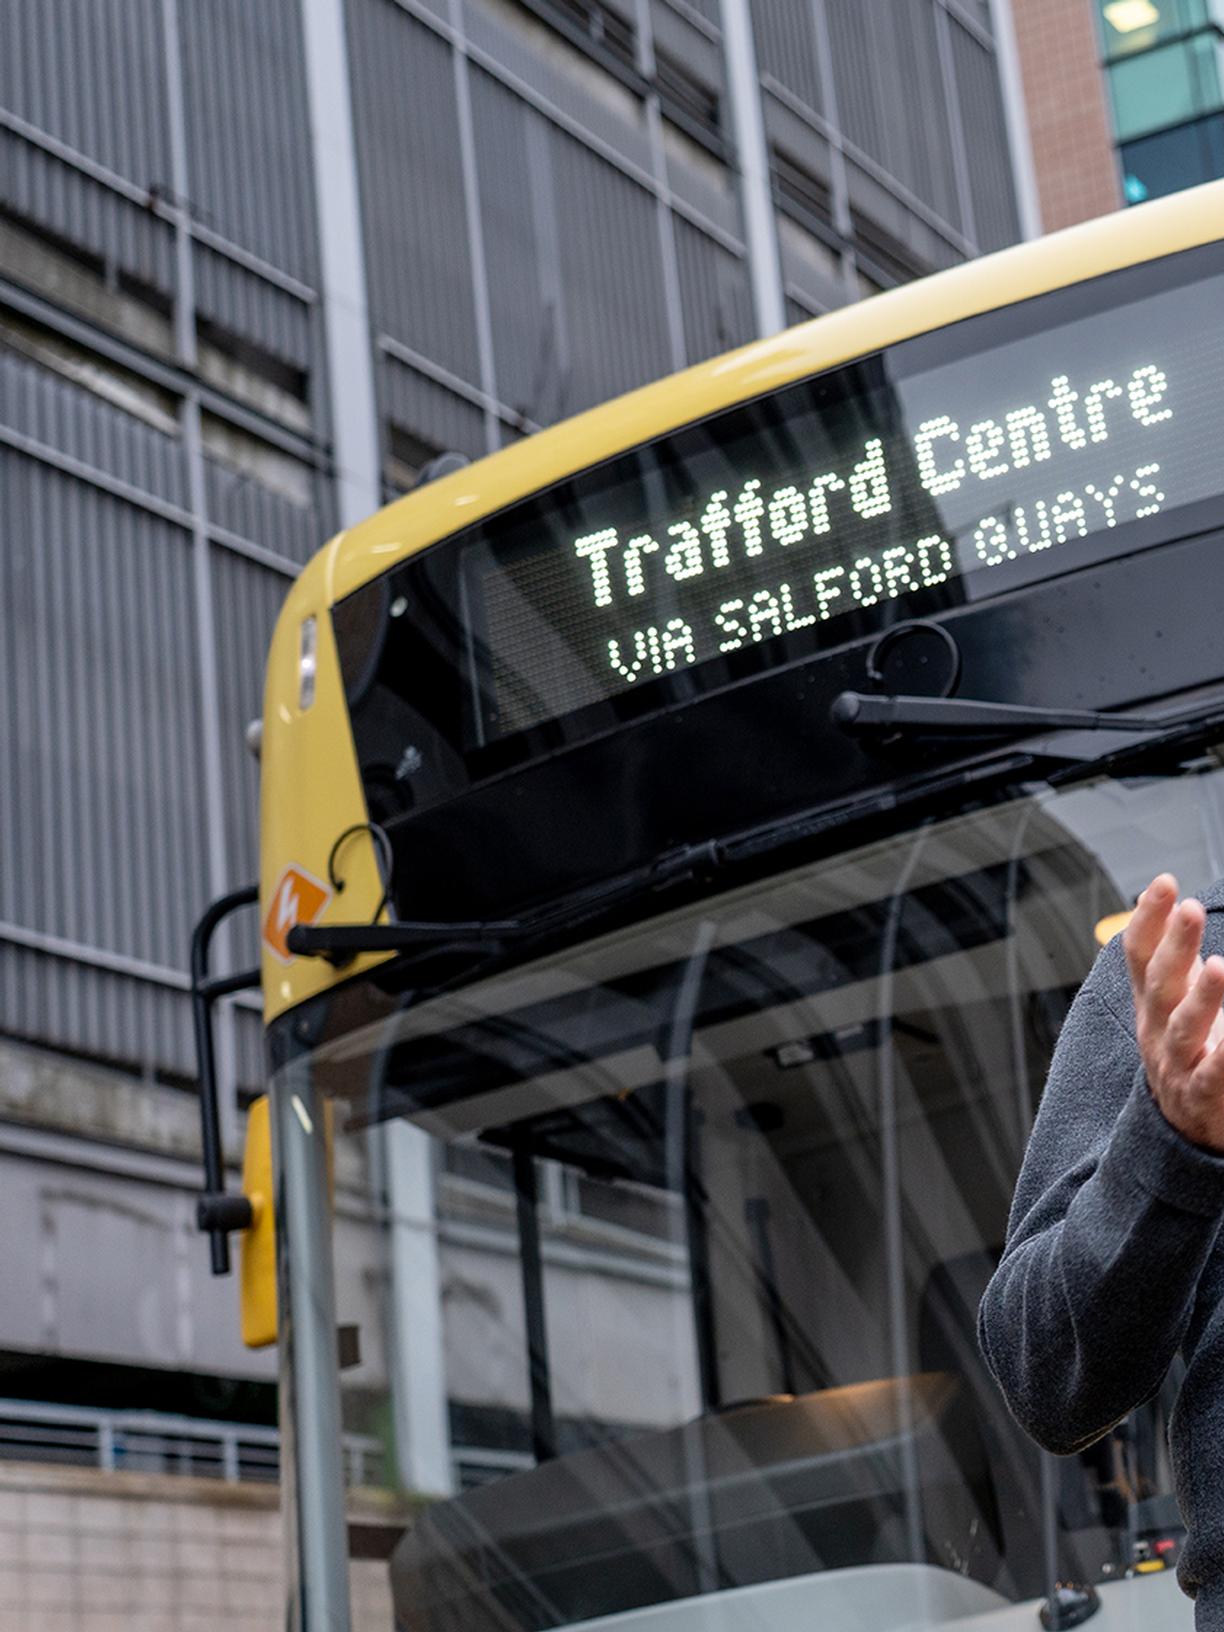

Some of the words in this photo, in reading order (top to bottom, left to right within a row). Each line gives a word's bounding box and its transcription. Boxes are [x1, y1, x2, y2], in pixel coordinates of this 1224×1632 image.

[574, 438, 891, 606] Trafford
[914, 364, 1172, 495] Centre
[608, 618, 695, 682] VIA
[715, 535, 952, 651] SALFORD
[974, 463, 1166, 565] QUAYS
